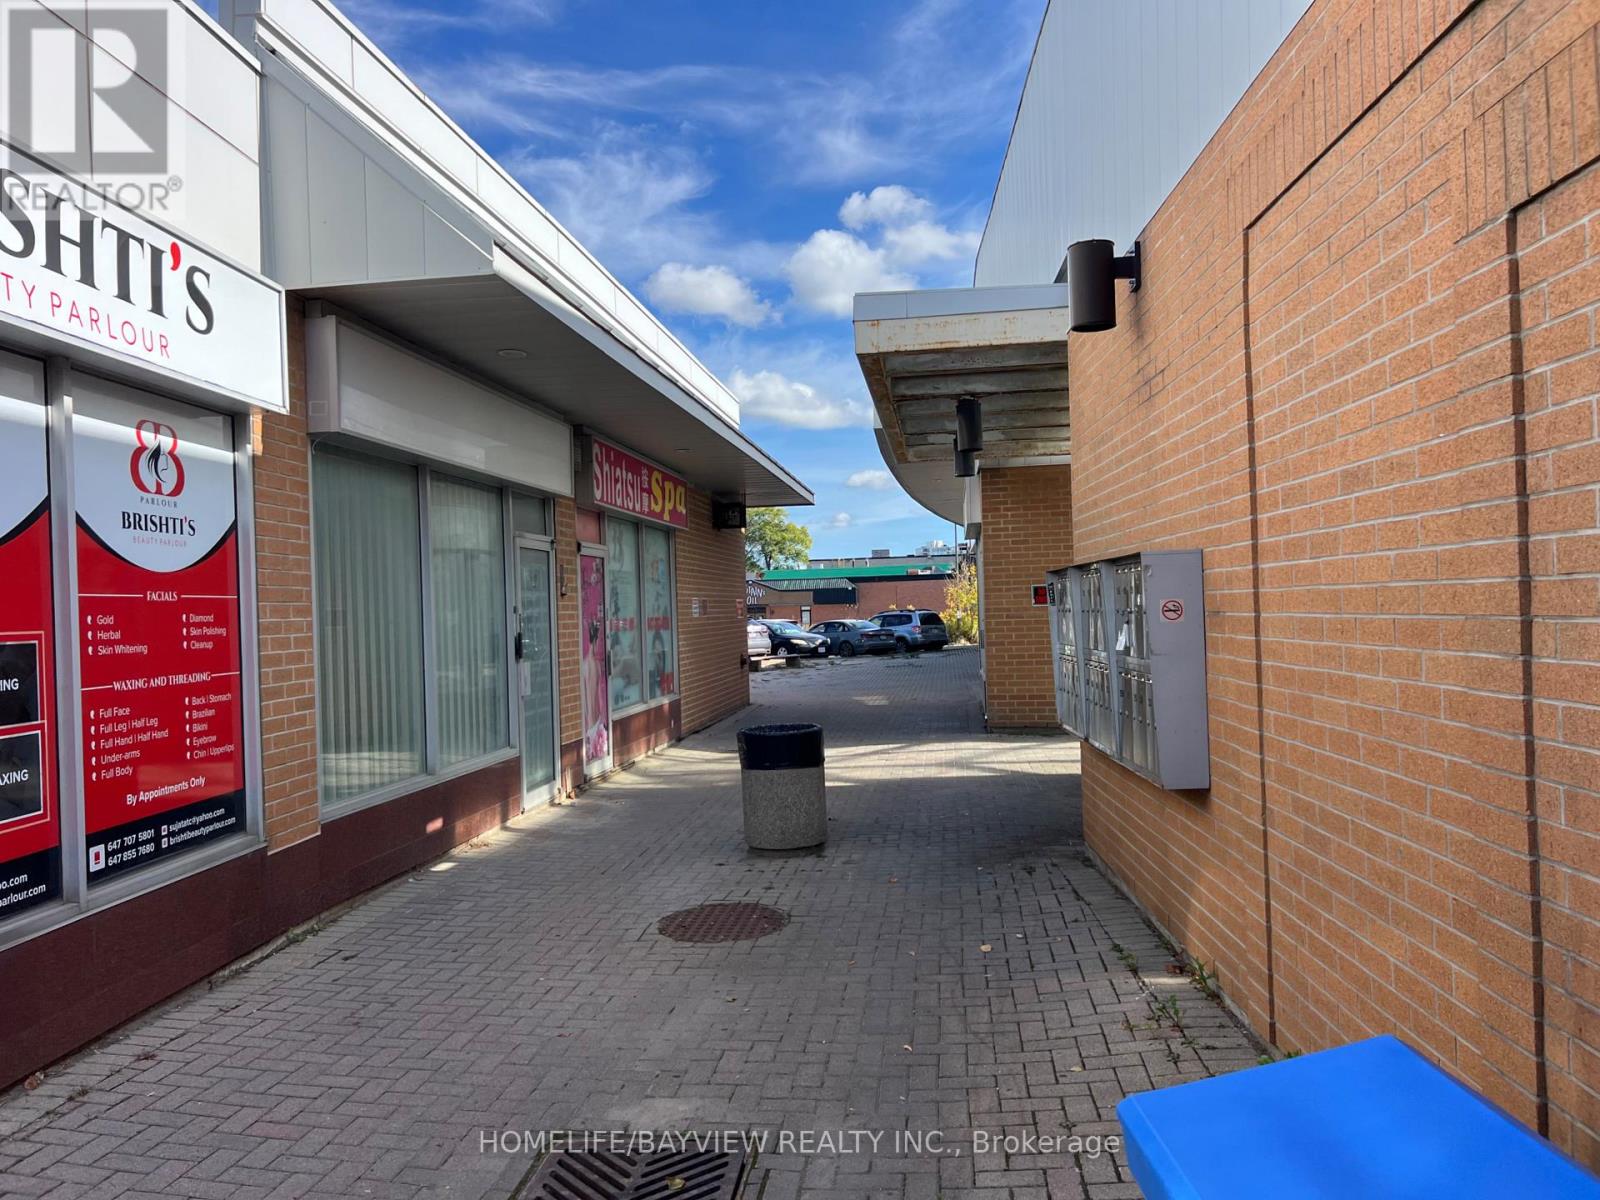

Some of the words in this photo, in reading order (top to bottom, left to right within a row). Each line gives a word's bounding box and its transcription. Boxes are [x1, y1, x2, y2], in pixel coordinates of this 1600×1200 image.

[51, 291, 170, 359] PARLOUR
[593, 443, 641, 513] Shiatsu
[140, 496, 178, 508] PARLOUR
[651, 470, 687, 521] Spa
[121, 511, 196, 537] BRISHTI'S
[146, 591, 178, 601] FACIALS
[96, 615, 114, 625] Gold
[189, 614, 214, 623] Diamond
[97, 630, 121, 640] Herbal
[190, 627, 202, 636] Skin
[203, 627, 227, 637] Polishing
[97, 645, 114, 655] Skin
[114, 644, 148, 655] Whitening
[190, 640, 214, 650] Cleanup
[113, 679, 148, 691] WAXING
[149, 676, 167, 687] AND
[168, 672, 211, 685] THREADING
[191, 696, 206, 706] Back
[209, 692, 232, 704] Stomach
[99, 708, 113, 718] Full
[113, 706, 131, 717] Face
[191, 708, 216, 719] Brazilian
[100, 723, 113, 734] Full
[114, 721, 127, 733] Leg
[131, 717, 146, 729] Half
[146, 716, 159, 728] Leg
[192, 723, 208, 733] Bikini
[100, 739, 113, 749] Full
[114, 734, 133, 747] Hand
[137, 731, 152, 743] Half
[151, 728, 169, 740] Hand
[192, 735, 217, 747] Eyebrow
[101, 749, 141, 765] Under-arms
[193, 748, 207, 759] Chin
[101, 769, 114, 780] Full
[115, 765, 134, 778] Body
[126, 793, 137, 806] By
[139, 780, 189, 803] Appointments
[189, 775, 206, 788] Only
[169, 816, 236, 846] brishtibeautyparlour.com
[107, 839, 121, 851] 647
[123, 835, 136, 846] 707
[138, 829, 155, 842] 5801
[107, 854, 121, 866] 647
[122, 848, 137, 860] 855
[137, 843, 155, 857] 7680
